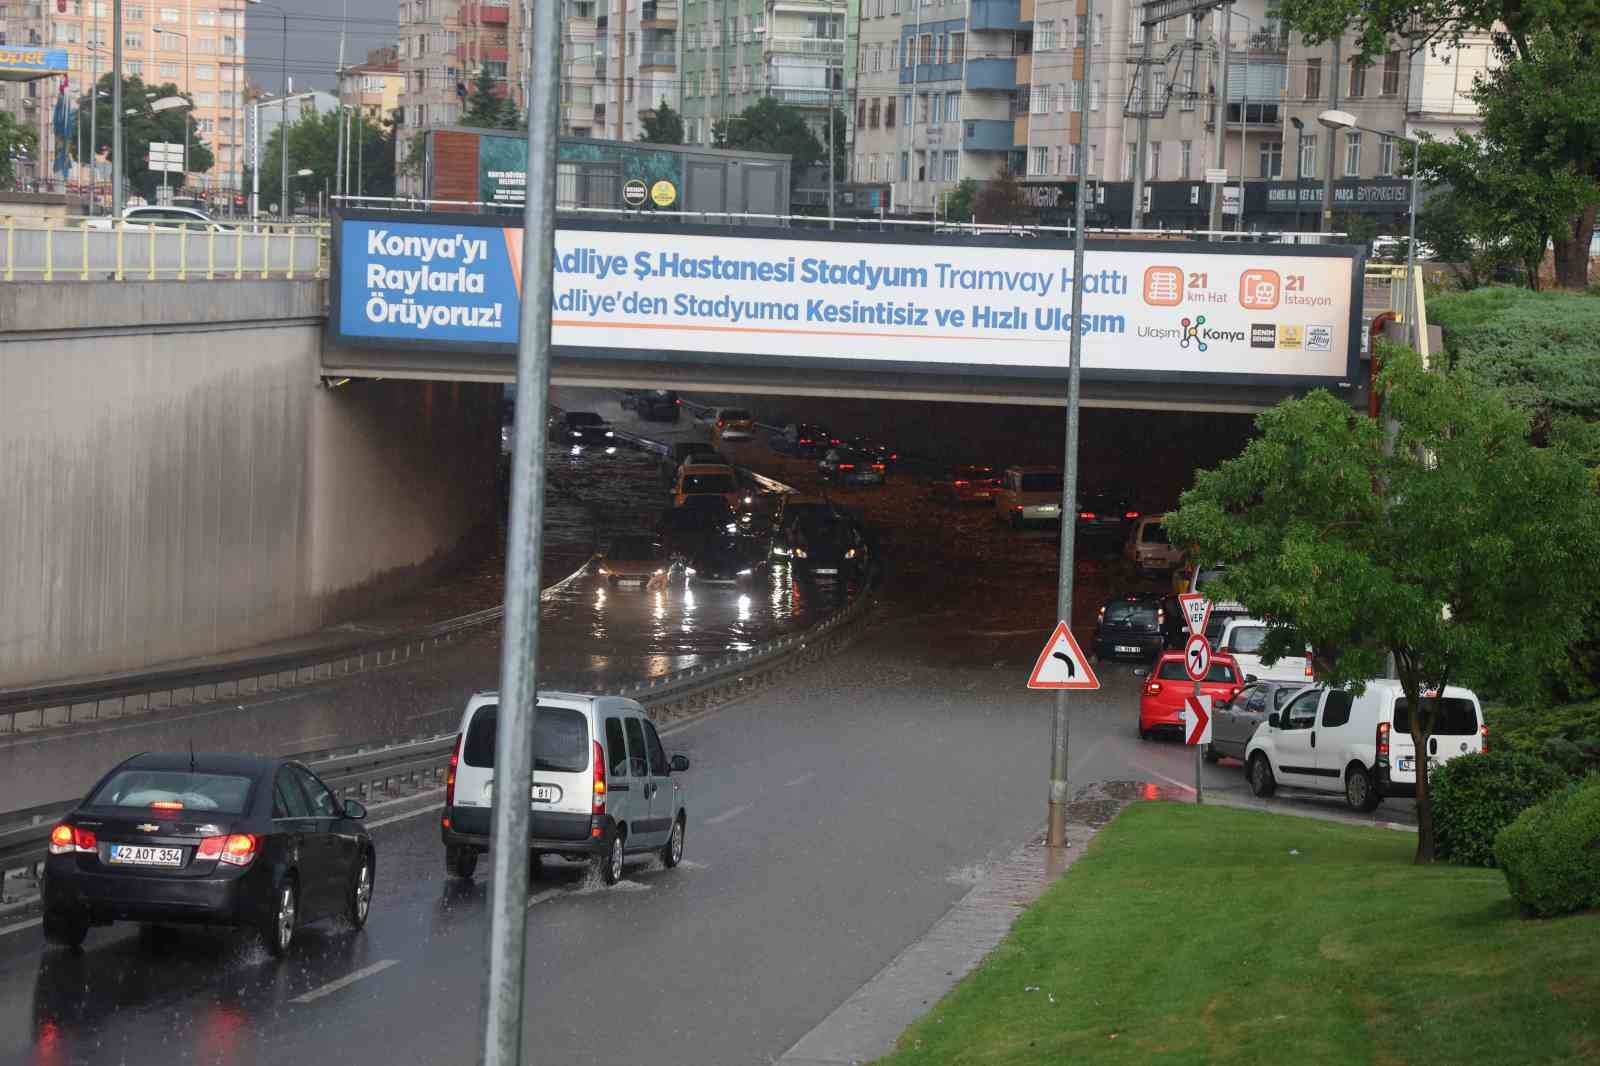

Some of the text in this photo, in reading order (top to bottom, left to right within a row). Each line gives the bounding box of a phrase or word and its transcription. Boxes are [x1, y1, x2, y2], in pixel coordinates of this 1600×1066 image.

[367, 229, 487, 264] Konya'yı
[367, 263, 485, 295] Raylarla
[634, 251, 796, 282] Ş.Hastanesi
[800, 257, 928, 291] Stadyum
[934, 263, 1053, 297] Tramvay
[1187, 272, 1209, 289] 21
[1284, 275, 1305, 292] 21
[1187, 291, 1228, 304] km Hat
[366, 291, 503, 329] Örüyoruz!
[673, 293, 799, 323] Stadyuma
[806, 299, 928, 326] Kesintisiz
[935, 308, 965, 328] ve
[972, 305, 1027, 330] Hızlı
[1137, 326, 1245, 343] Ulaşım Konya
[1189, 601, 1206, 611] YOL
[118, 846, 132, 859] 42
[159, 850, 179, 862] 354
